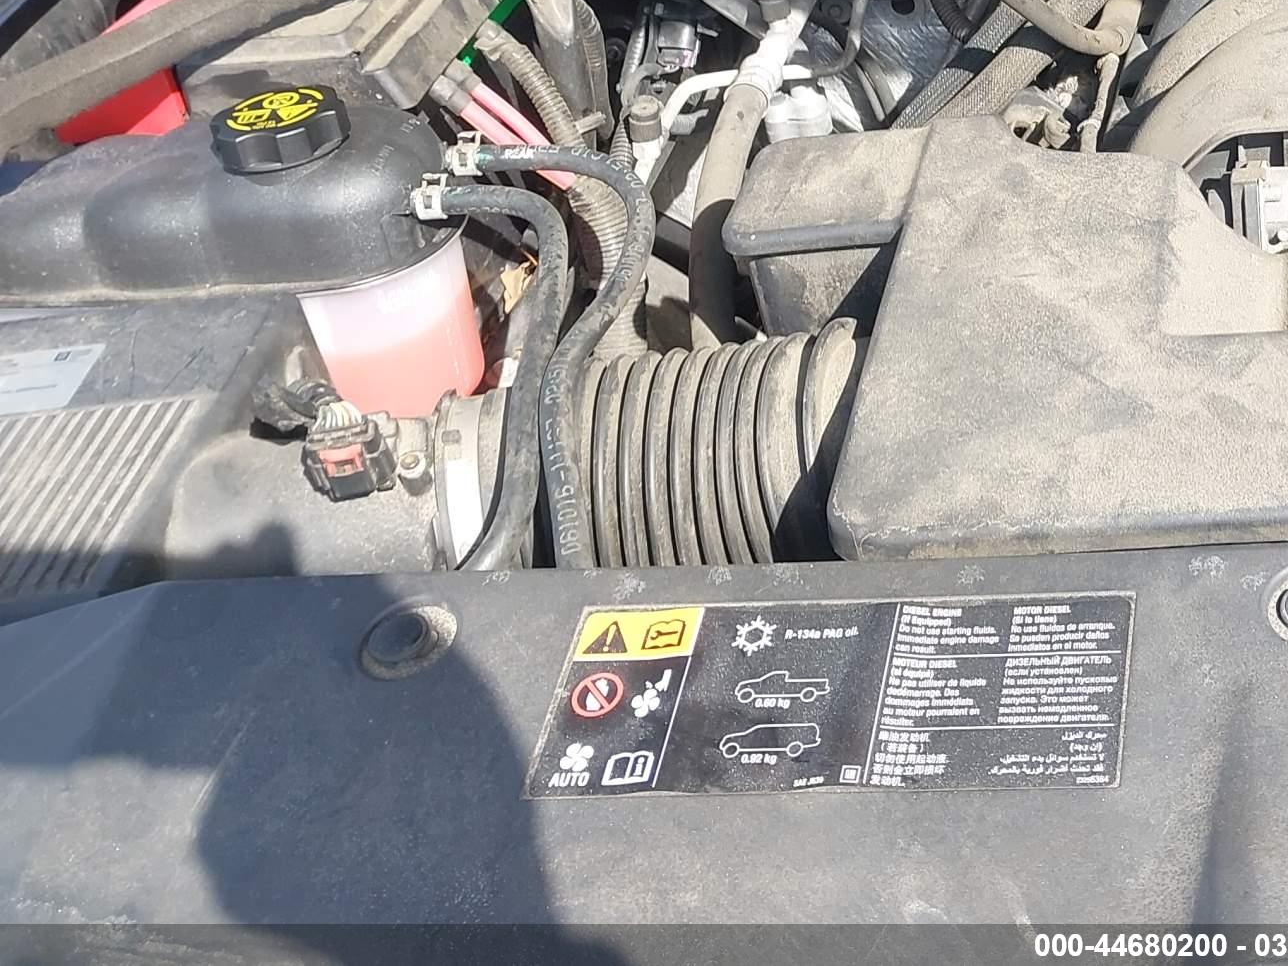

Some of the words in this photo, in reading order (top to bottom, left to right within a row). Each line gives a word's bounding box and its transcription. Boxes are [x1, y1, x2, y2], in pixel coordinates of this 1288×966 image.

[902, 605, 930, 616] DIESEL
[932, 608, 962, 617] ENGINE
[1013, 607, 1043, 615] MOTOR
[1044, 605, 1071, 614] DIESEL
[899, 624, 910, 633] Do
[911, 625, 925, 634] not
[926, 627, 940, 635] use
[942, 626, 972, 636] starting
[1011, 625, 1022, 633] No
[1023, 625, 1038, 633] use
[1039, 624, 1065, 633] fluidos
[1066, 623, 1077, 631] de
[785, 629, 821, 640] R-134a
[897, 633, 939, 644] Immediate
[940, 636, 967, 645] engine
[967, 636, 1000, 645] damage
[1009, 634, 1020, 643] Se
[1021, 634, 1051, 643] pueden
[1051, 632, 1085, 642] producir
[895, 644, 910, 652] can
[892, 657, 928, 668] MOTEUR
[928, 660, 958, 668] DIESEL
[1004, 654, 1061, 667] ДИЗЕЛЬНЫЙ
[1060, 655, 1113, 666] ДВИГАТЕЛЬ
[1004, 668, 1029, 677] (если
[888, 676, 901, 686] Ne
[901, 679, 918, 688] pas
[947, 679, 959, 687] de
[1002, 677, 1016, 686] Не
[1016, 675, 1074, 686] используйте
[1001, 686, 1047, 696] жидкости
[1046, 685, 1065, 695] для
[1065, 684, 1114, 694] холодного
[754, 698, 776, 708] 0.60
[777, 698, 791, 709] kg
[884, 696, 931, 708] dommages
[1039, 694, 1058, 704] Это
[882, 707, 894, 715] au
[895, 707, 926, 716] moteur
[740, 754, 763, 764] 0.92
[763, 753, 778, 765] kg
[548, 772, 590, 787] AUTO
